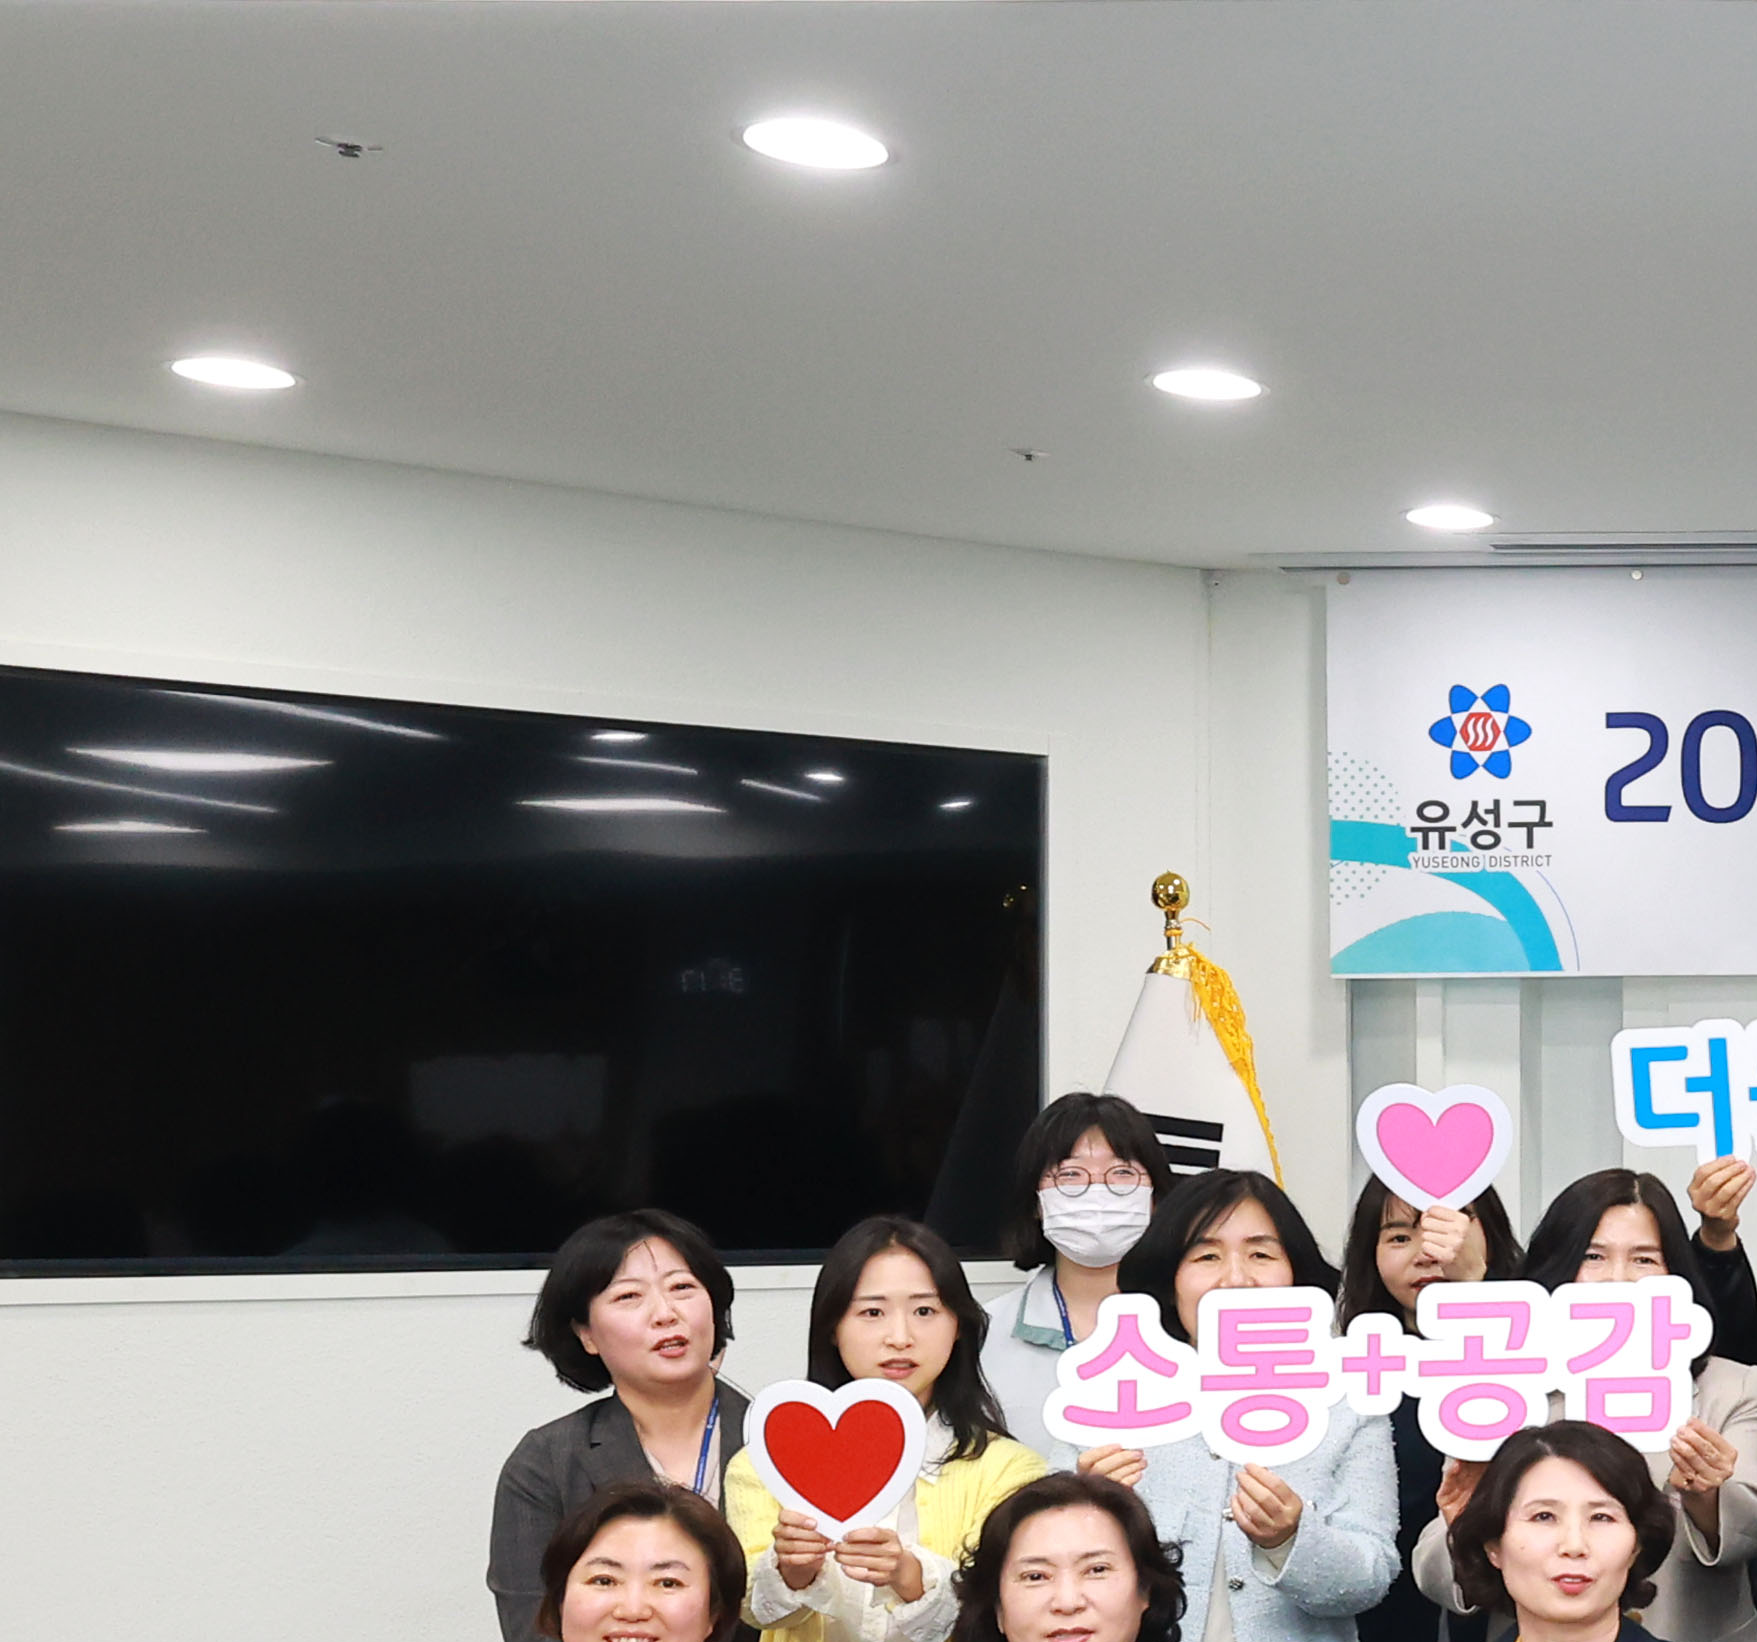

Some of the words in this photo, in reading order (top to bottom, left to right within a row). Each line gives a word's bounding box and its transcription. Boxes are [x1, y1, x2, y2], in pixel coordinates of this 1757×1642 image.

[1410, 799, 1554, 851] 유성구
[1412, 855, 1481, 869] YUSEONG
[1488, 854, 1553, 868] DISTRICT
[1062, 1294, 1693, 1448] 소통+공감
